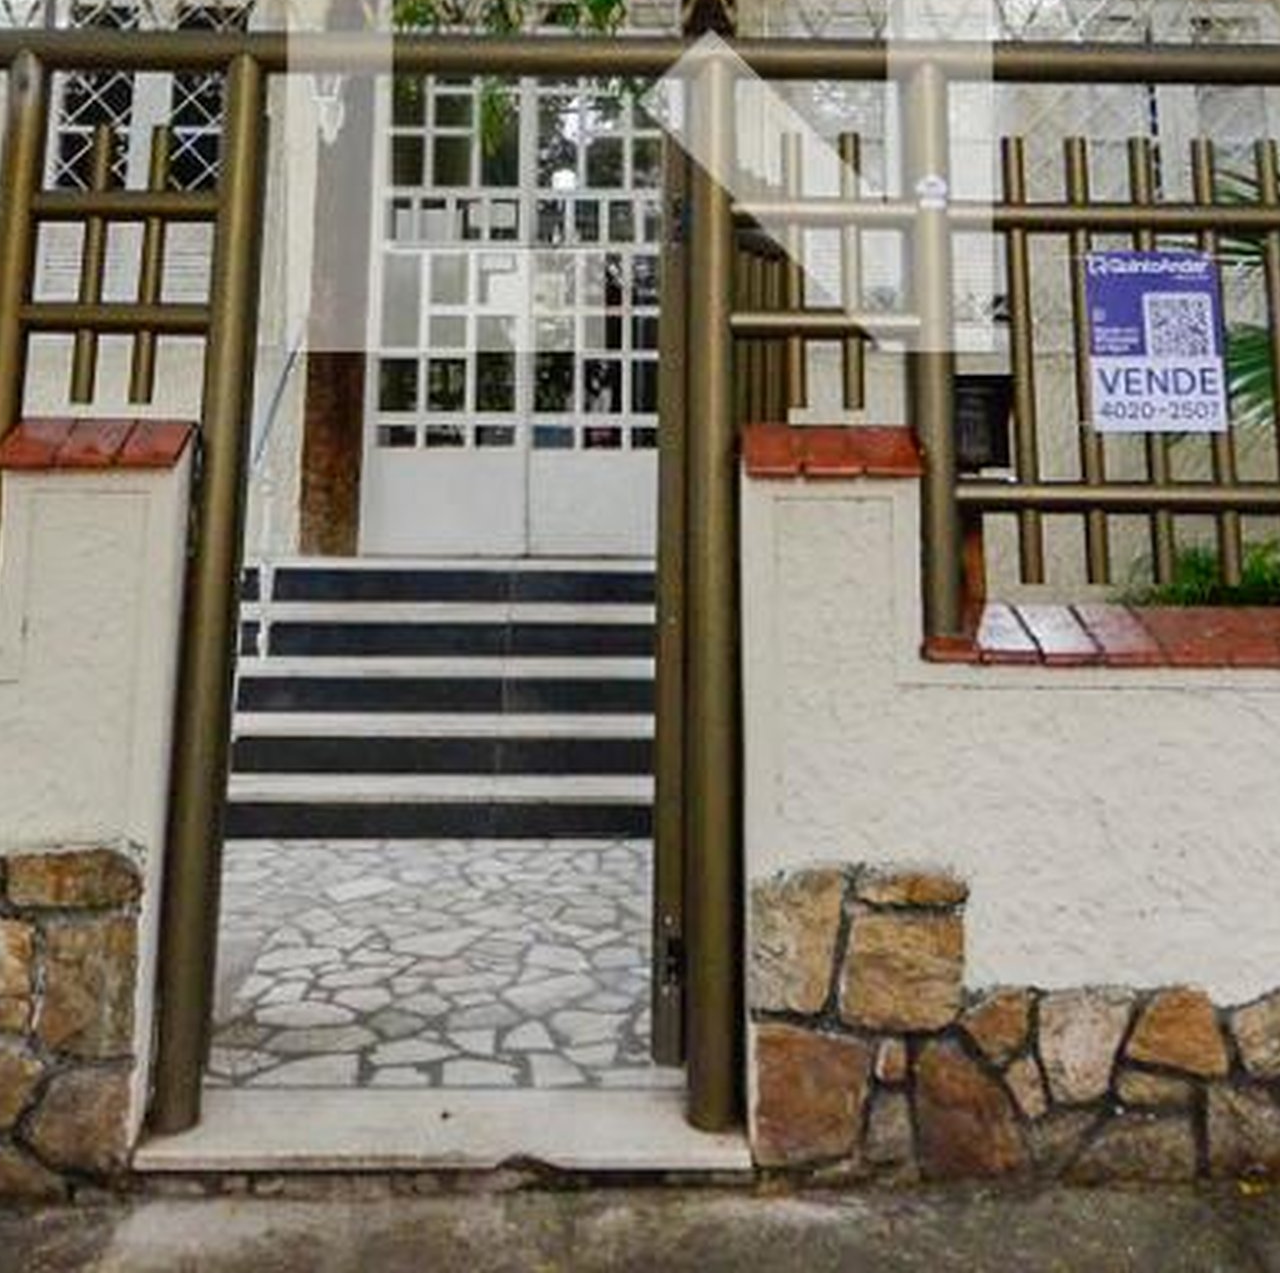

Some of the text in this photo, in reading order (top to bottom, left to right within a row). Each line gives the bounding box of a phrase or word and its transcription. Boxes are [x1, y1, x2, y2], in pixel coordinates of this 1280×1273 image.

[1108, 257, 1210, 274] QuintoAndar
[1097, 367, 1219, 396] VENDE
[1100, 401, 1220, 420] 4020-2507
